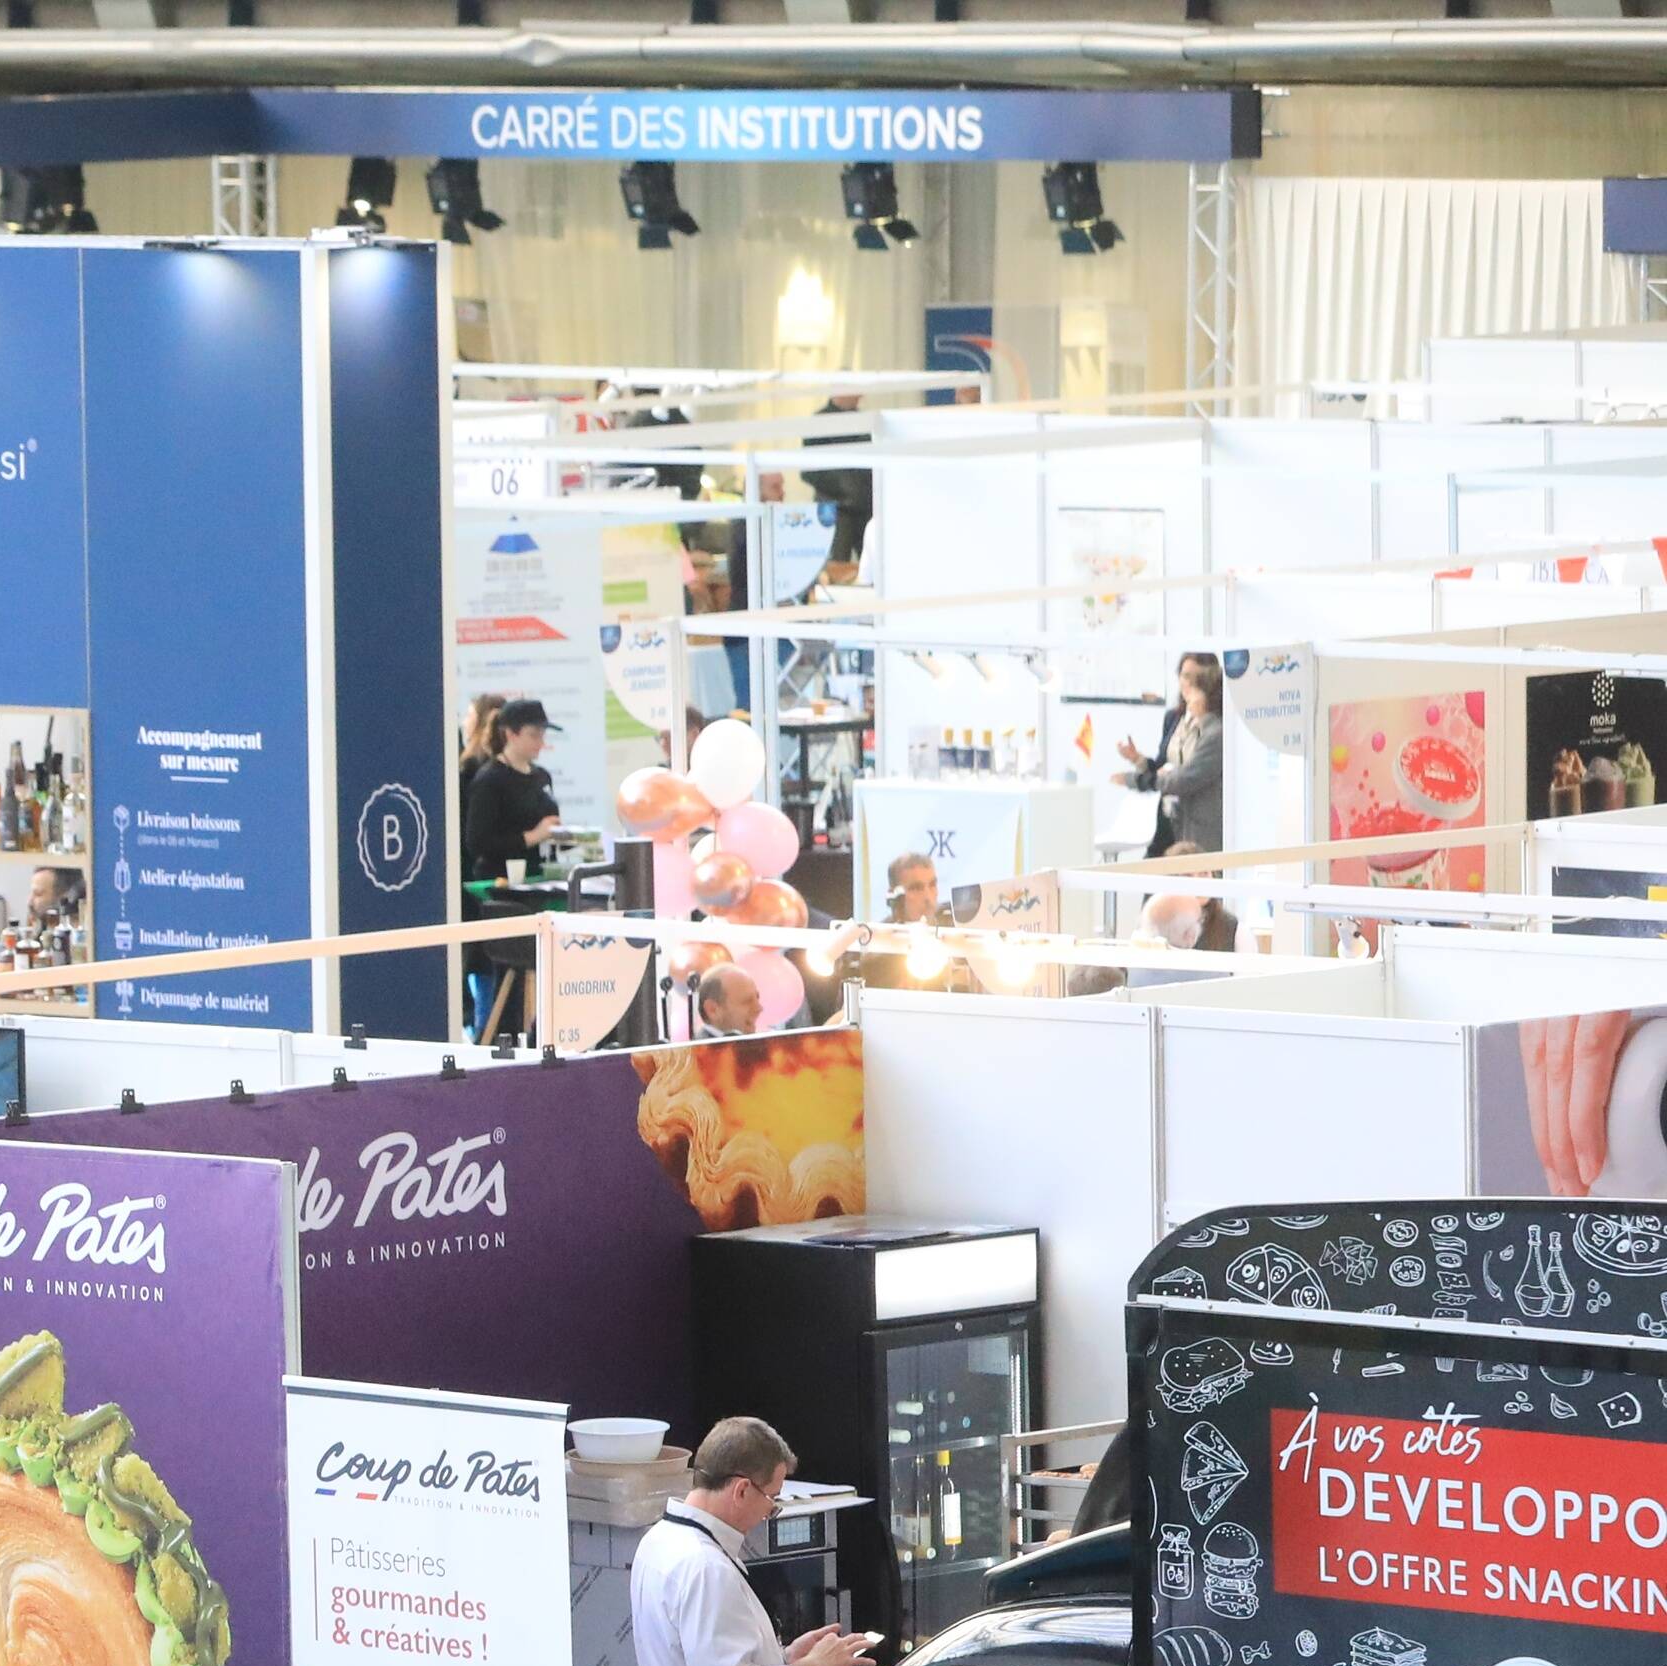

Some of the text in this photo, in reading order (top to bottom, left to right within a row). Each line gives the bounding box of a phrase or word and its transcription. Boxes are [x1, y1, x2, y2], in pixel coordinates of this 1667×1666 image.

[471, 96, 984, 151] CARRÉ DES INSTITUTIONS
[491, 468, 520, 496] 06
[1589, 711, 1617, 727] moka
[137, 725, 262, 751] Accompagnement
[160, 753, 239, 773] sur mesure
[137, 810, 242, 833] Livraison boissons
[382, 814, 404, 860] B
[139, 867, 245, 891] Atelier dégustation
[140, 928, 204, 948] Installation
[205, 931, 219, 949] de
[141, 986, 270, 1014] Dépannage de matériel
[559, 979, 616, 996] LONGDRINX
[558, 1027, 580, 1042] C 35
[346, 1248, 356, 1266] &
[370, 1231, 507, 1262] INNOVATION
[25, 1278, 35, 1294] &
[45, 1278, 165, 1303] INNOVATION
[316, 1440, 541, 1503] Coup de Pates
[469, 1502, 541, 1520] INNOVATION
[330, 1536, 447, 1579] Pâtisseries
[1318, 1546, 1468, 1597] L'OFFRE
[331, 1585, 488, 1622] gourmandes
[332, 1619, 351, 1645] &
[360, 1622, 474, 1658] créatives
